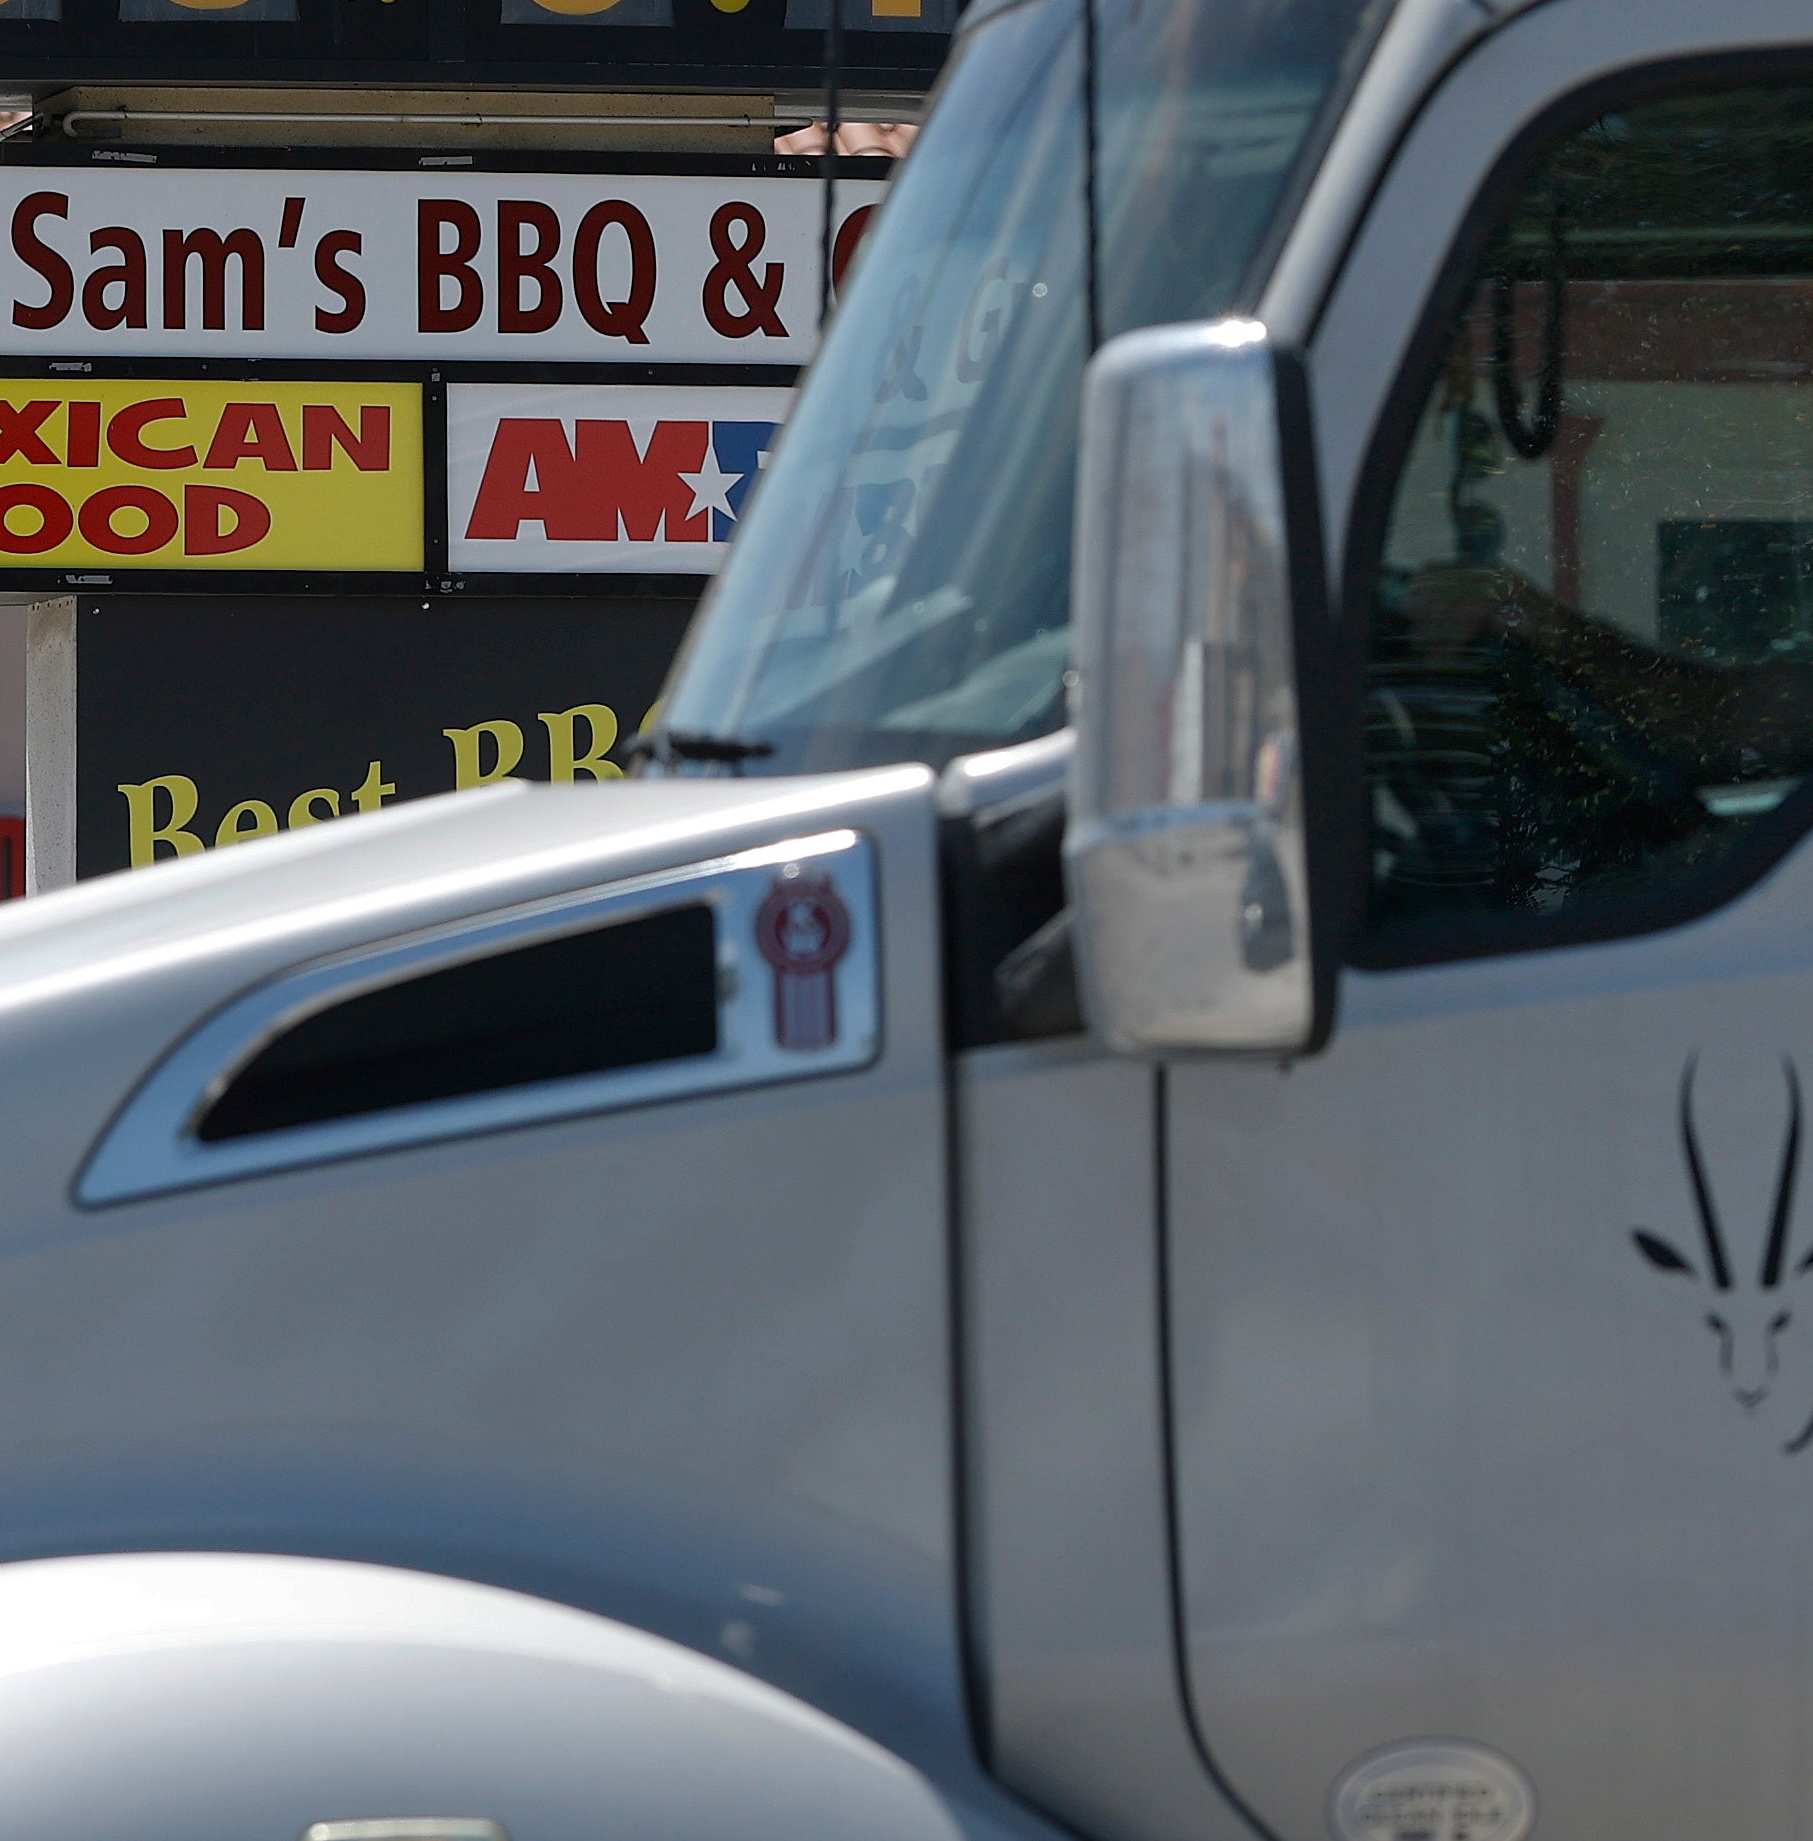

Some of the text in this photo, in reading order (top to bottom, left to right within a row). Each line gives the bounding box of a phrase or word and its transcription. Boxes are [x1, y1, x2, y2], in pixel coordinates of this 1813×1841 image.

[10, 190, 367, 335] Sam's
[416, 197, 658, 346] BBQ
[701, 201, 790, 340] &
[443, 699, 664, 793] BB
